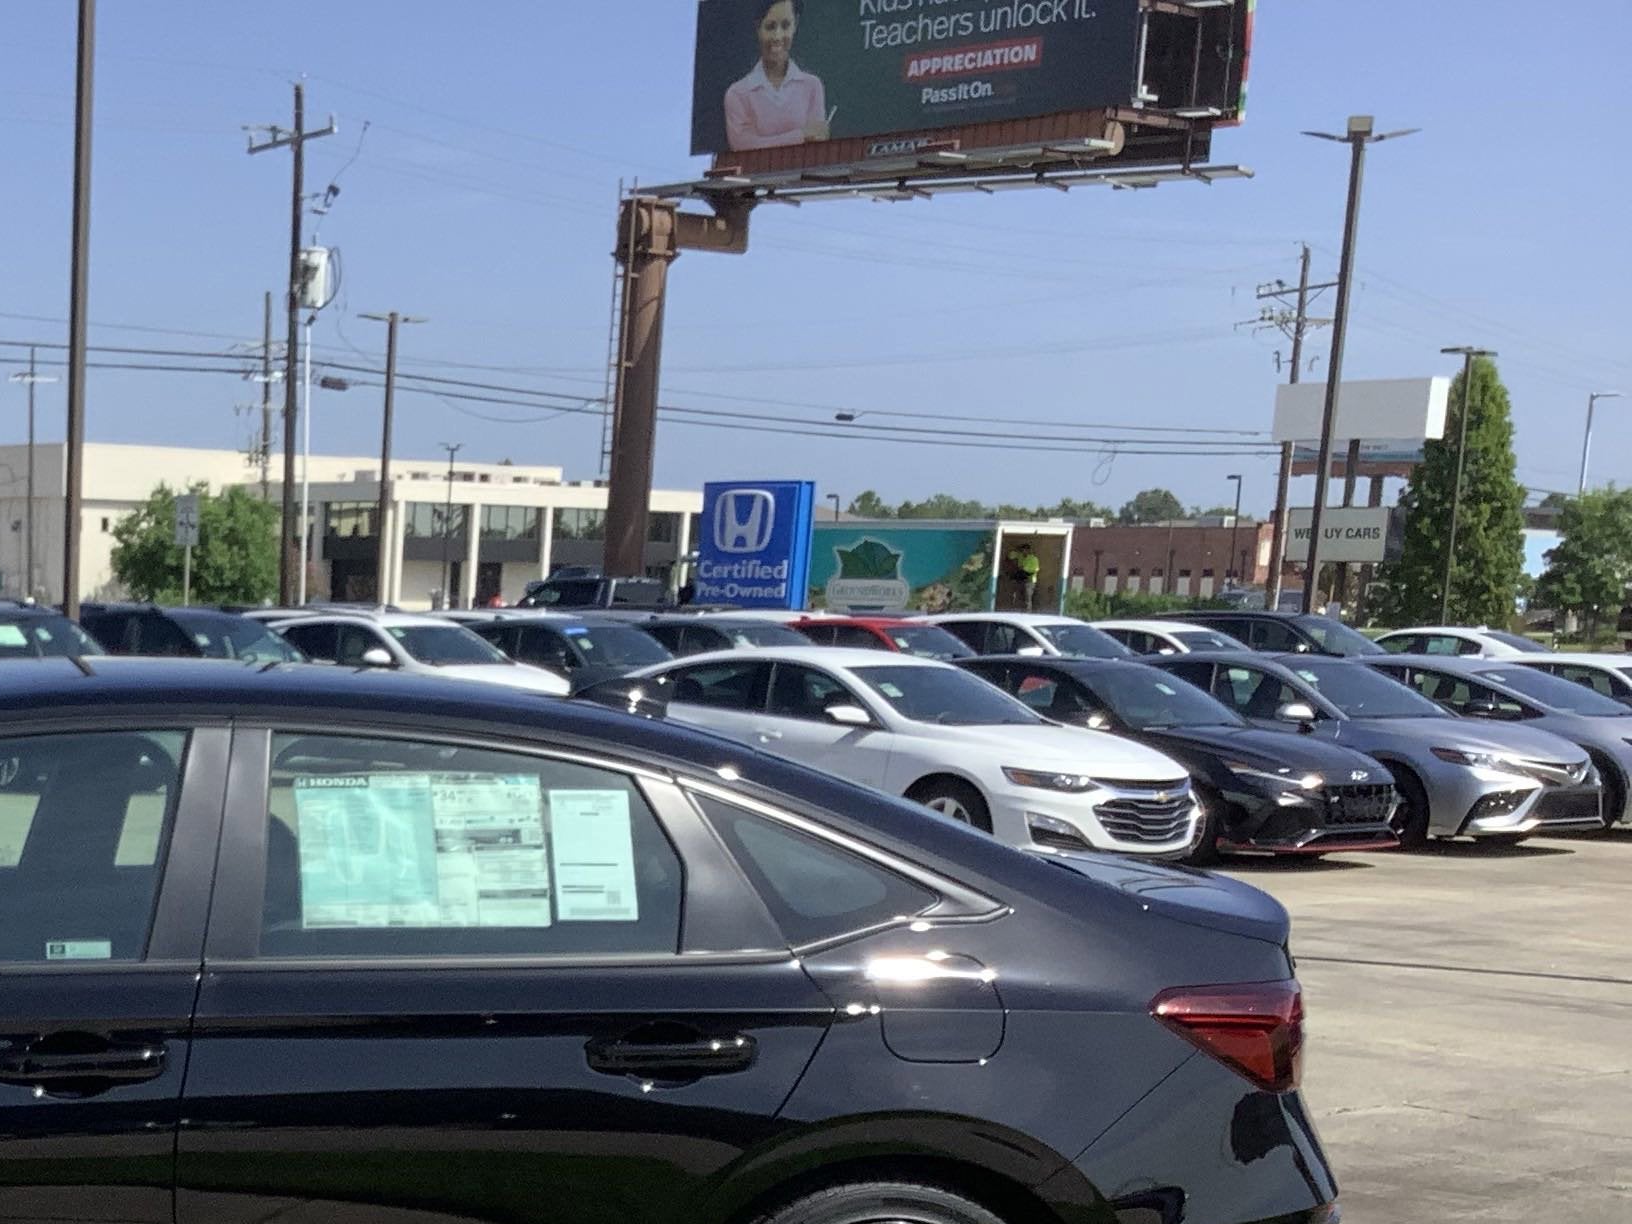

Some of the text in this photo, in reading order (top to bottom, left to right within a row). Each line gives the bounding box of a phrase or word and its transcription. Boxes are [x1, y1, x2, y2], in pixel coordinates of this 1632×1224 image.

[860, 12, 974, 49] Teachers
[979, 0, 1067, 33] unlock
[907, 44, 1037, 77] APPRECIATION
[1345, 527, 1381, 540] CARS
[699, 559, 788, 579] Certified
[696, 582, 786, 598] Pre-Owned
[310, 777, 368, 787] HONDA
